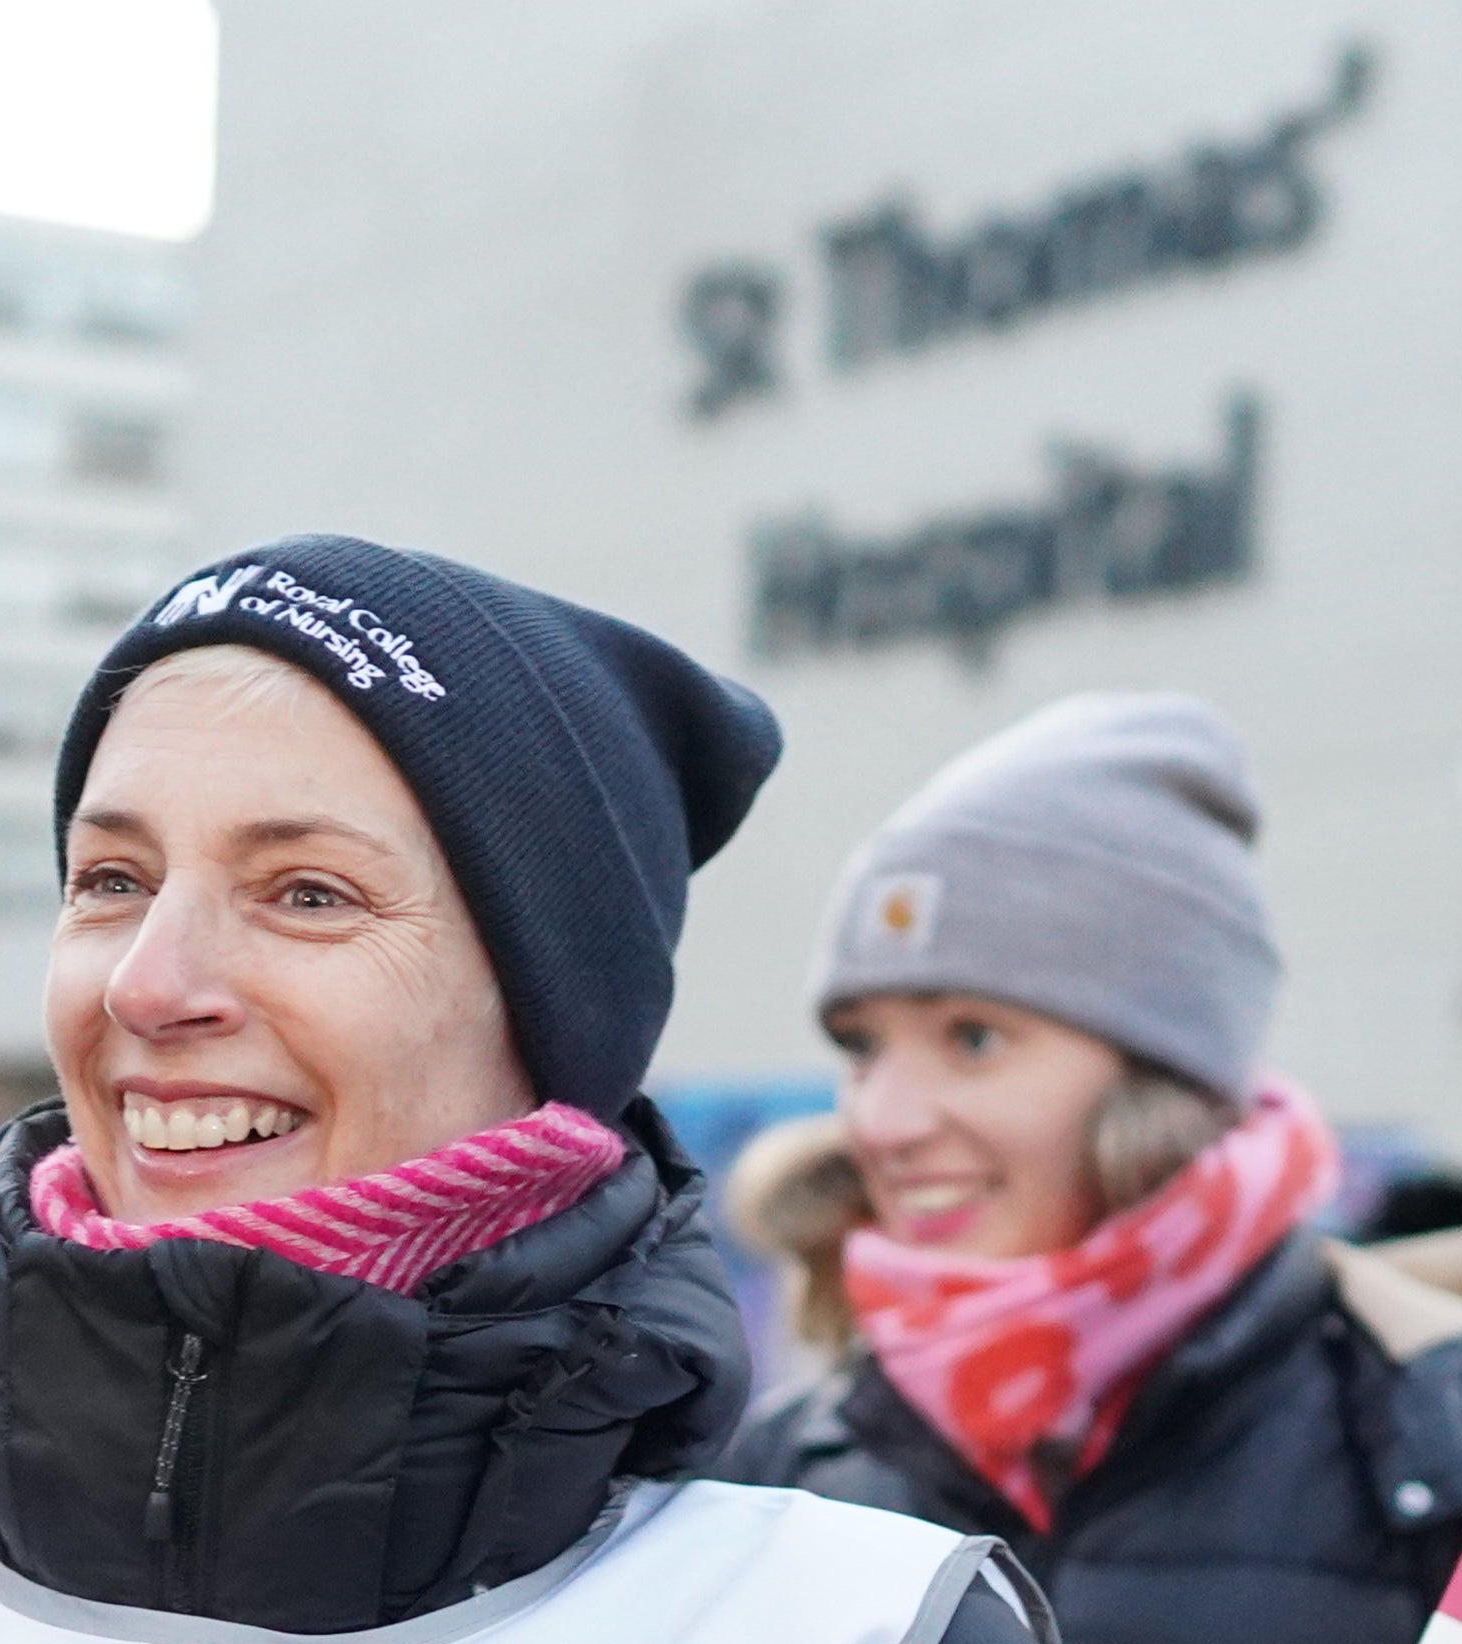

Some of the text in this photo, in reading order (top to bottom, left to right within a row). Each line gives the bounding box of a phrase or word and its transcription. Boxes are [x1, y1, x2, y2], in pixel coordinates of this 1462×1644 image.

[240, 595, 387, 690] of Nursing
[267, 570, 447, 701] Royal College
